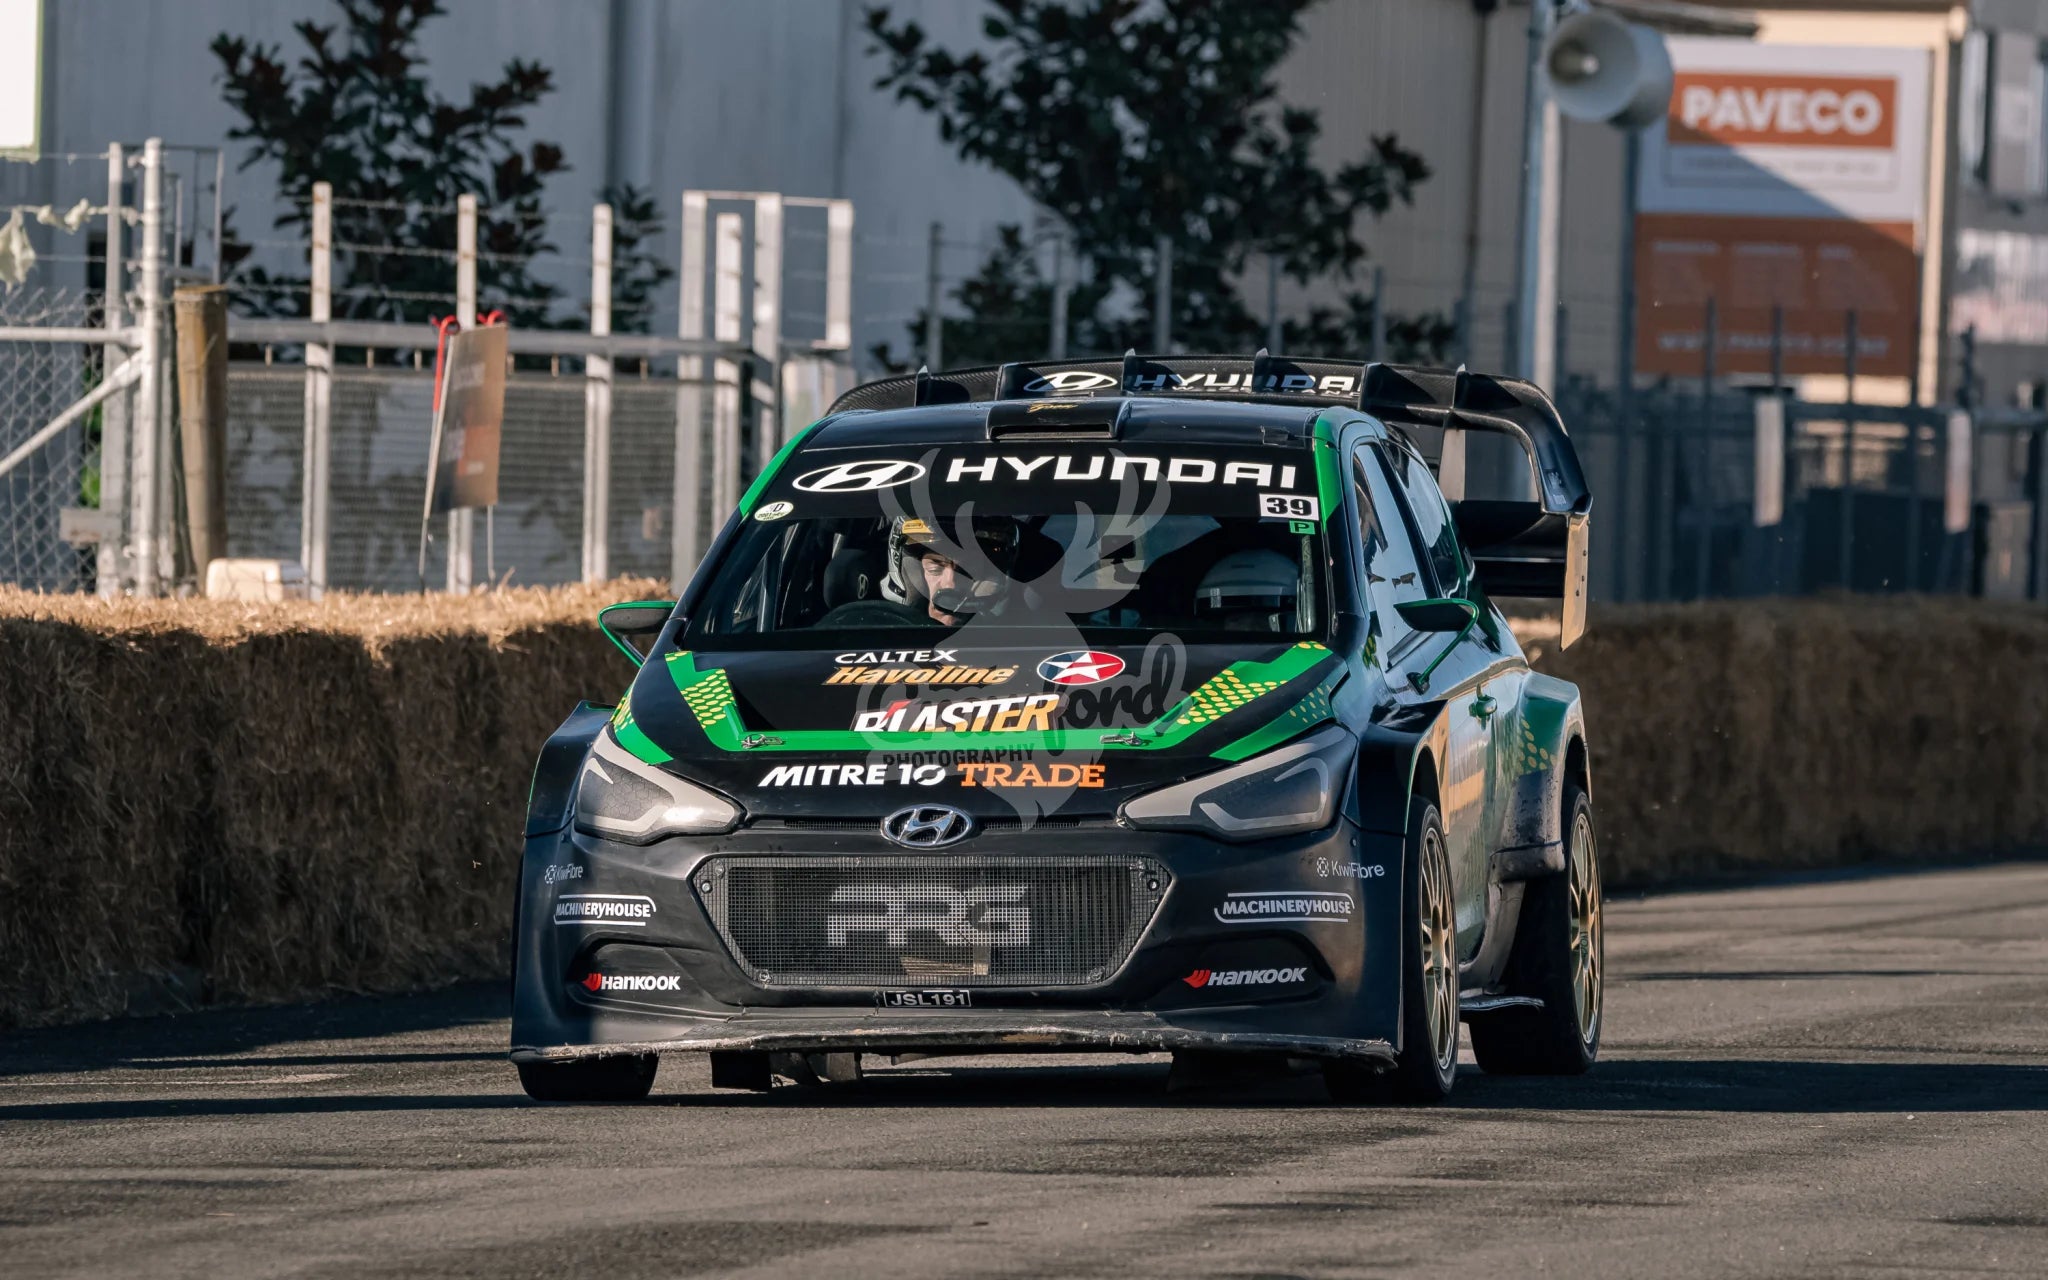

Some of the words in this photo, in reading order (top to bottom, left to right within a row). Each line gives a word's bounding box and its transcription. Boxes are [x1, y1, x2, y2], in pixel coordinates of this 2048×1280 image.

[1682, 85, 1883, 135] PAVECO
[1133, 373, 1362, 392] HYUNDA
[946, 455, 1297, 489] HYUNDAI
[1266, 497, 1312, 517] 39
[1294, 522, 1310, 533] P
[834, 649, 959, 665] CALTEX
[823, 663, 1018, 686] Havoline
[758, 763, 889, 788] MITRE
[896, 763, 947, 787] 10
[957, 763, 1106, 789] TRADE
[1331, 860, 1386, 879] KiwiFibre
[555, 902, 652, 919] MACHINERYHOUSE
[1222, 899, 1352, 916] MACHINERYHOUSE
[890, 993, 970, 1007] JSL191
